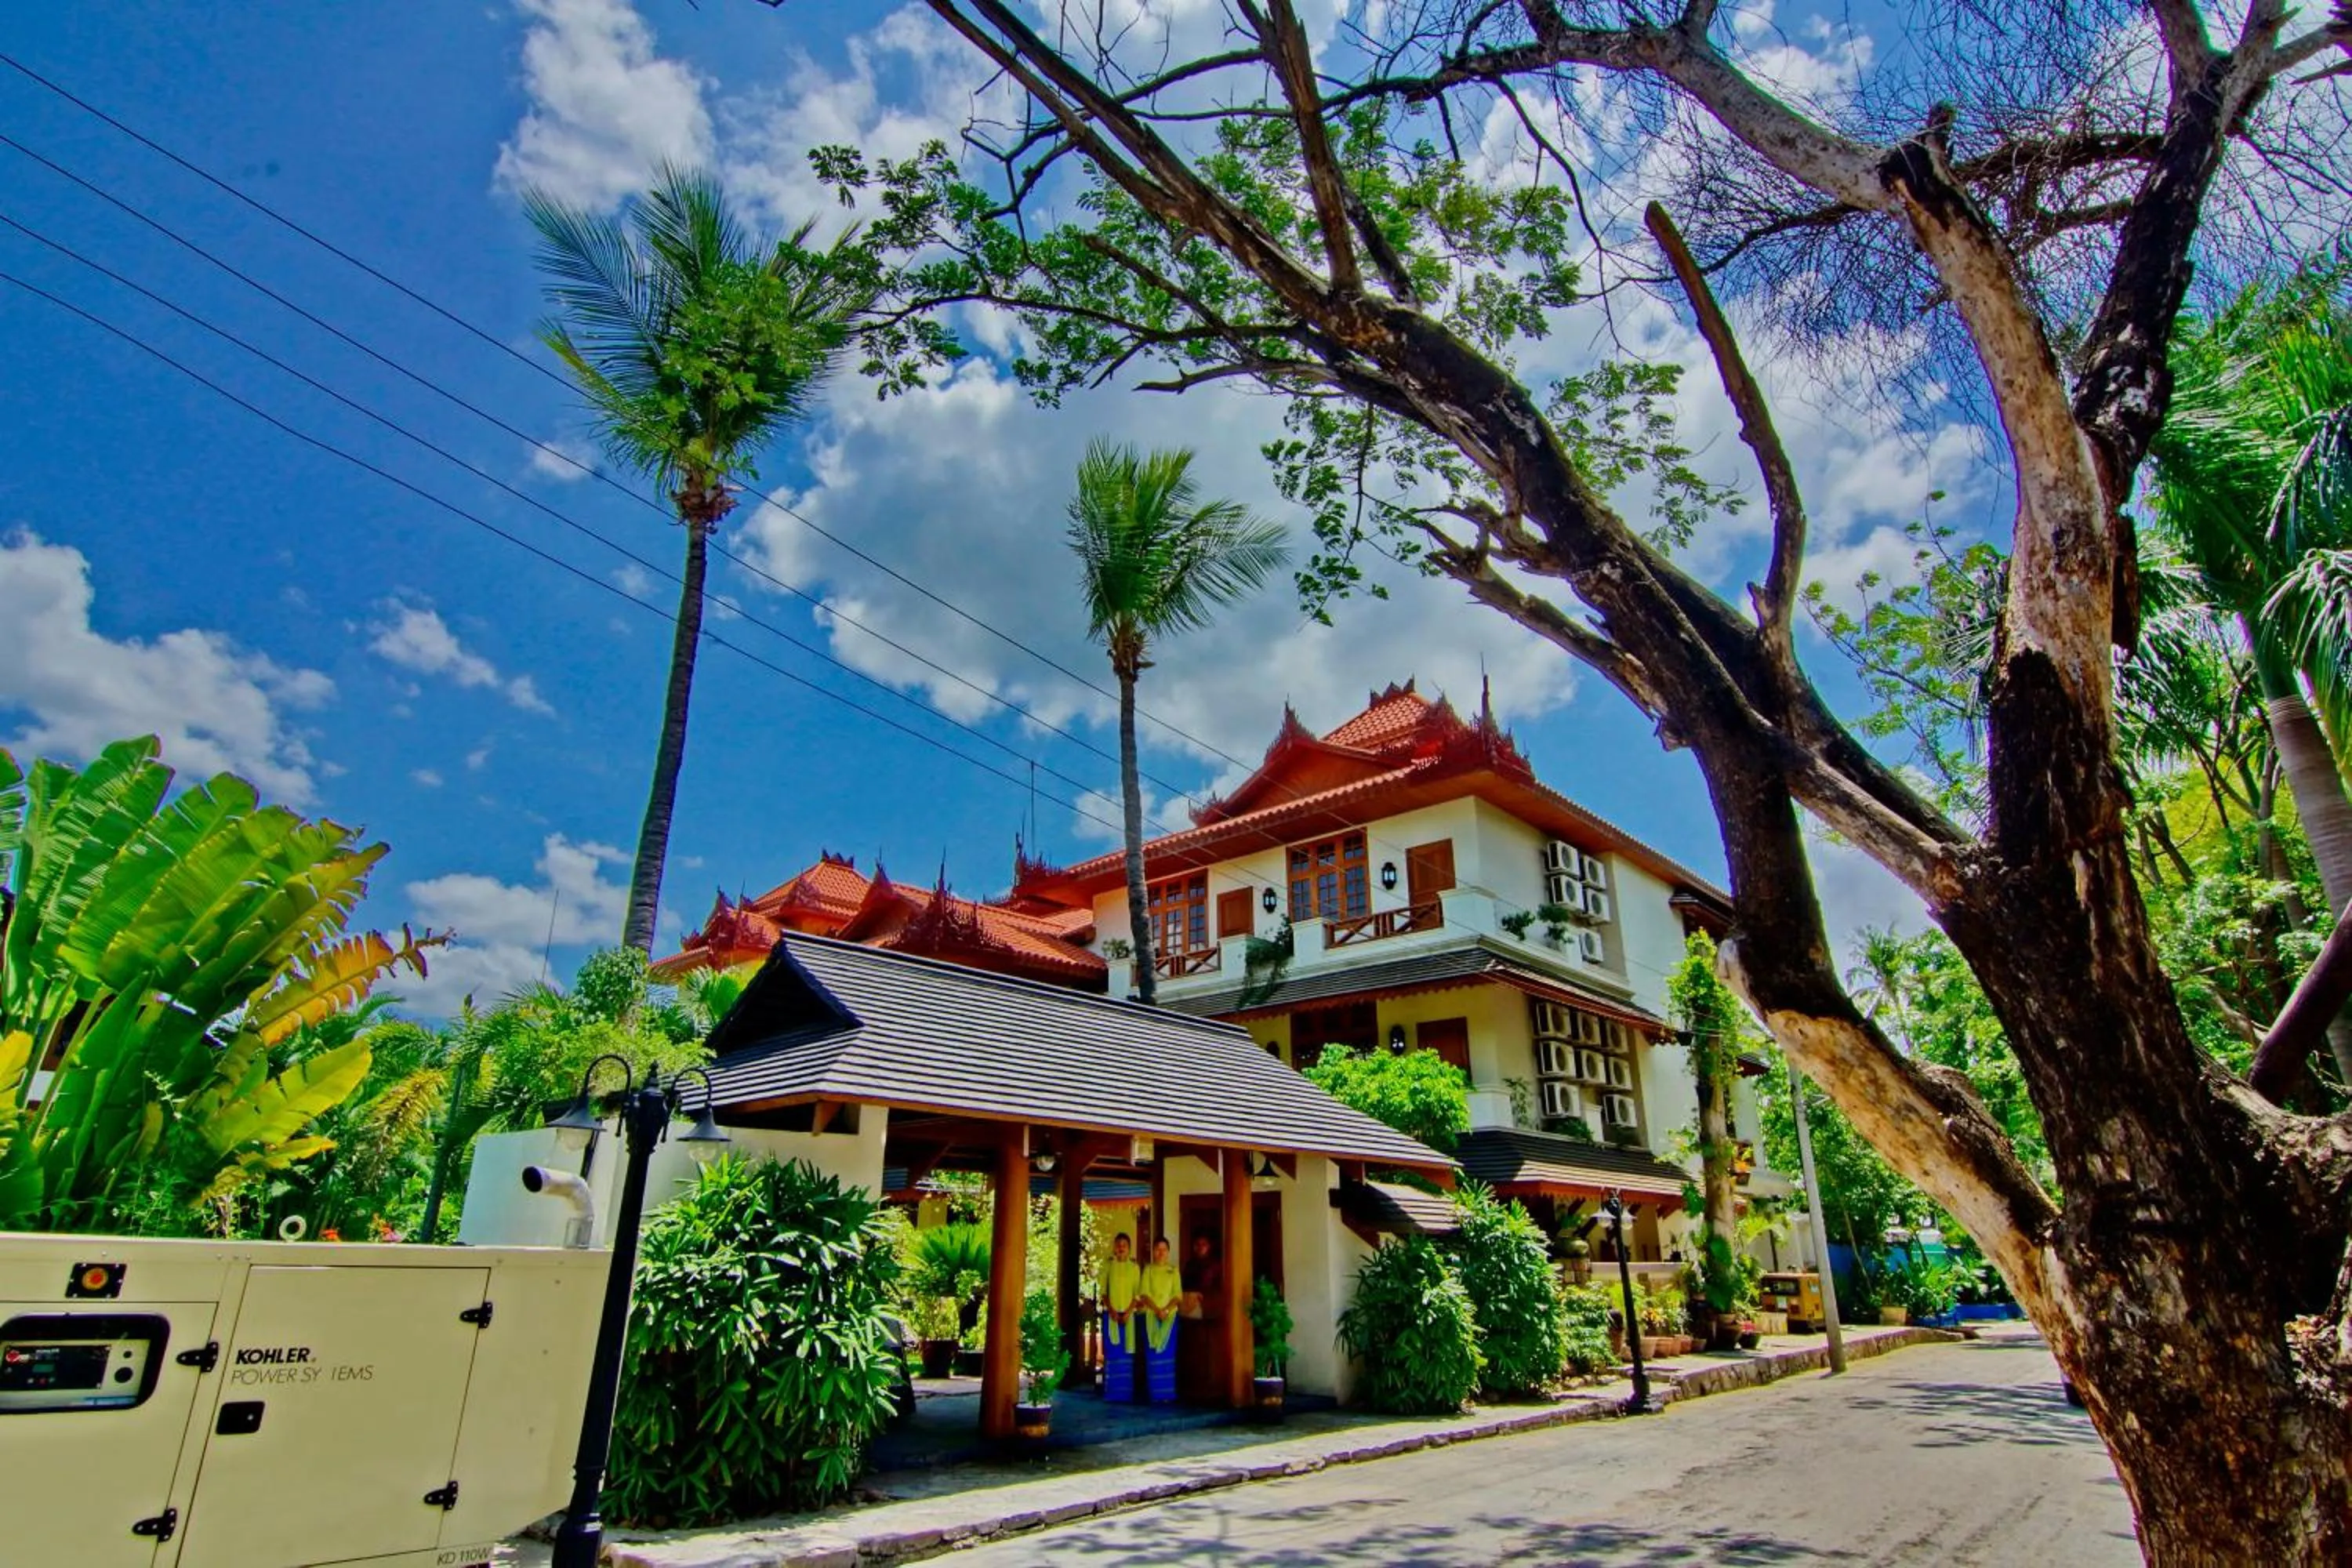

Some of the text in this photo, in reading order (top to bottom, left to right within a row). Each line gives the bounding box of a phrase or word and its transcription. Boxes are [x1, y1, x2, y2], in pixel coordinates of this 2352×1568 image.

[235, 1348, 310, 1365] KOHLER
[230, 1367, 298, 1385] POWER
[437, 1552, 456, 1566] KD
